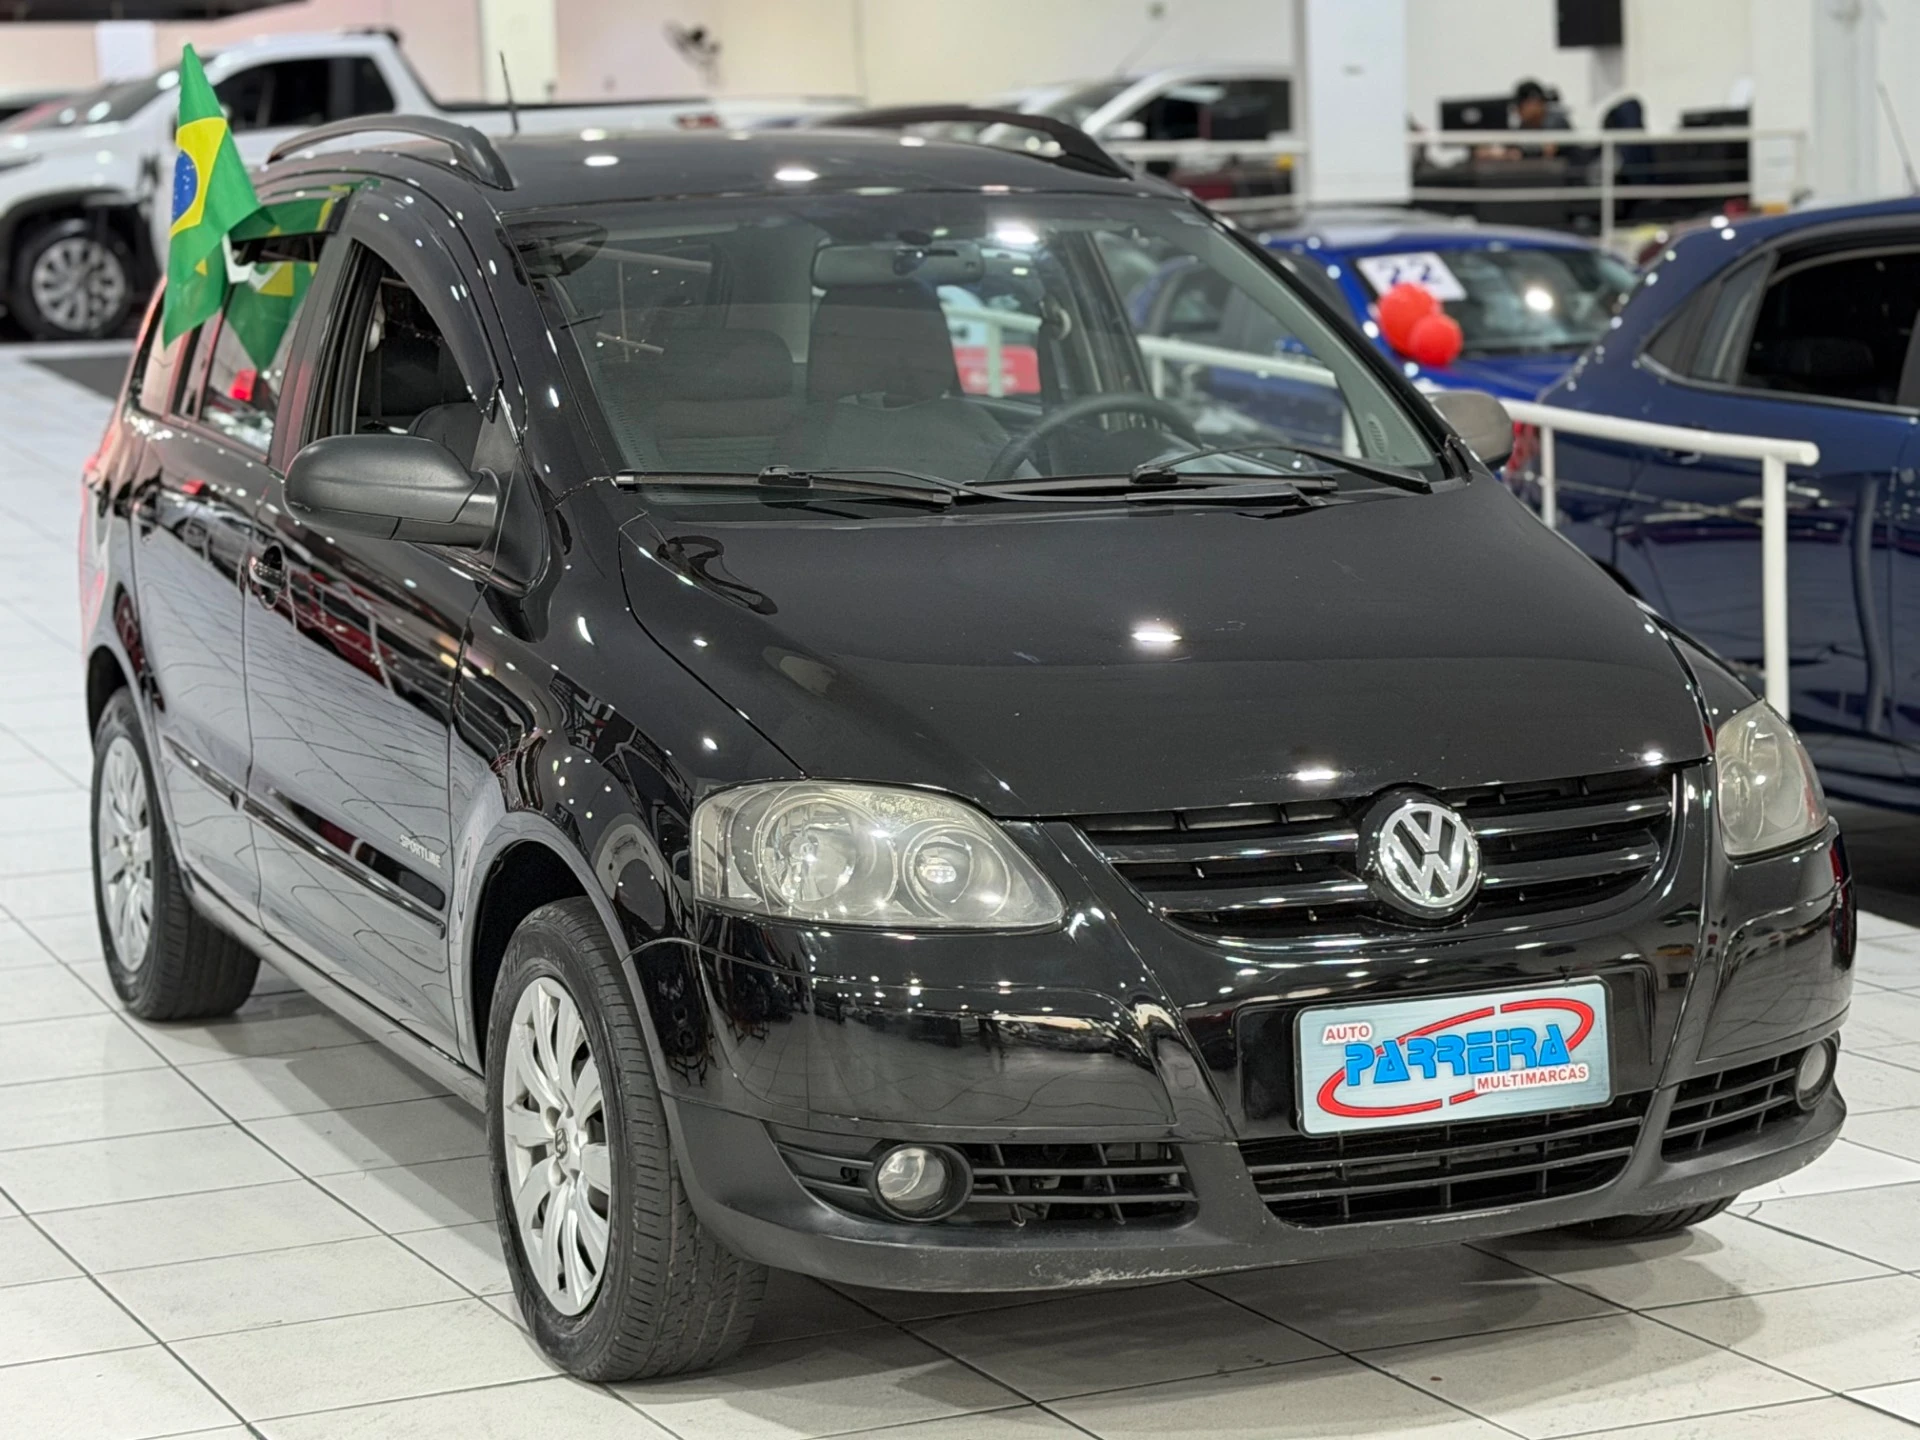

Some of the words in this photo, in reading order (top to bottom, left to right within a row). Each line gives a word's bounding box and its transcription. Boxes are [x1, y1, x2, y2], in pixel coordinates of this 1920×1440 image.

[1325, 1025, 1370, 1041] AUTO
[1345, 1024, 1570, 1086] PARREIRA
[1477, 1066, 1587, 1090] MULTIMARCAS
